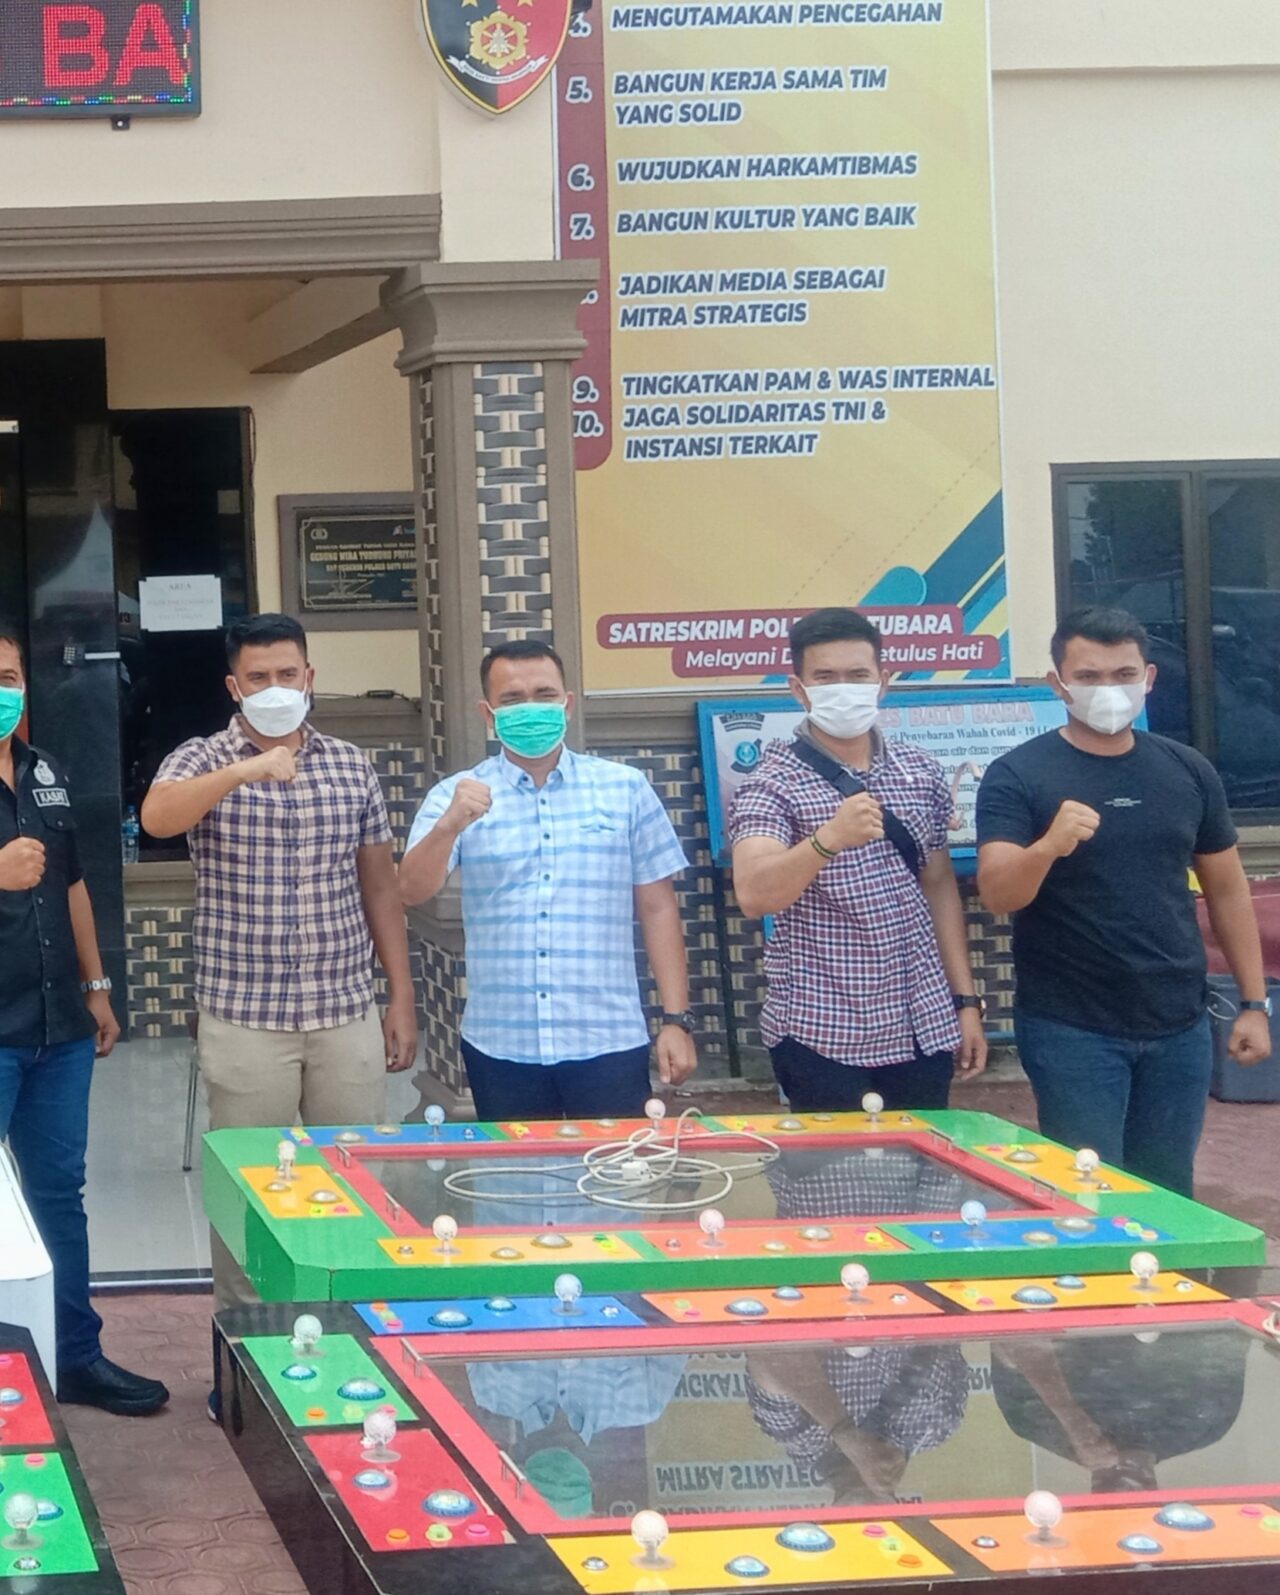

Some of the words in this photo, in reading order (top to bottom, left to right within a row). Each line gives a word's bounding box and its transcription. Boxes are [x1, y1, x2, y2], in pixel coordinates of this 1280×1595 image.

[612, 5, 794, 28] MENGUTAMAKAN
[799, 3, 942, 22] PENCEGAHAN
[42, 3, 186, 88] BA
[569, 80, 589, 99] 5.
[614, 73, 704, 95] BANGUN
[710, 71, 776, 91] KERJA
[783, 69, 844, 90] SAMA
[850, 69, 886, 88] TIM
[615, 104, 672, 126] YANG
[678, 103, 742, 123] SOLID
[571, 168, 591, 188] 6.
[617, 159, 740, 182] WUJUDKAN
[746, 155, 917, 178] HARKAMTIBMAS
[573, 219, 591, 238] 7.
[617, 211, 708, 233] BANGUN
[714, 207, 795, 230] KULTUR
[801, 207, 860, 228] YANG
[864, 206, 916, 226] BAIK
[619, 274, 714, 296] JADIKAN
[719, 271, 787, 293] MEDIA
[793, 269, 885, 290] SEBAGAI
[620, 306, 687, 328] MITRA
[693, 303, 807, 326] STRATEGIS
[575, 381, 596, 400] 9.
[622, 373, 758, 396] TINGKATKAN
[763, 372, 810, 392] PAM
[817, 371, 831, 390] &
[837, 369, 888, 389] WAS
[892, 367, 995, 388] INTERNAL
[623, 407, 681, 429] JAGA
[686, 402, 825, 426] SOLIDARITAS
[832, 402, 866, 422] TNI
[871, 401, 886, 420] &
[626, 435, 721, 459] INSTANSI
[729, 433, 816, 456] TERKAIT
[609, 619, 743, 643] SATRESKRIM
[686, 648, 776, 671] Melayani
[881, 644, 937, 663] etulus
[942, 642, 983, 661] Hati
[990, 727, 1016, 738] Covid
